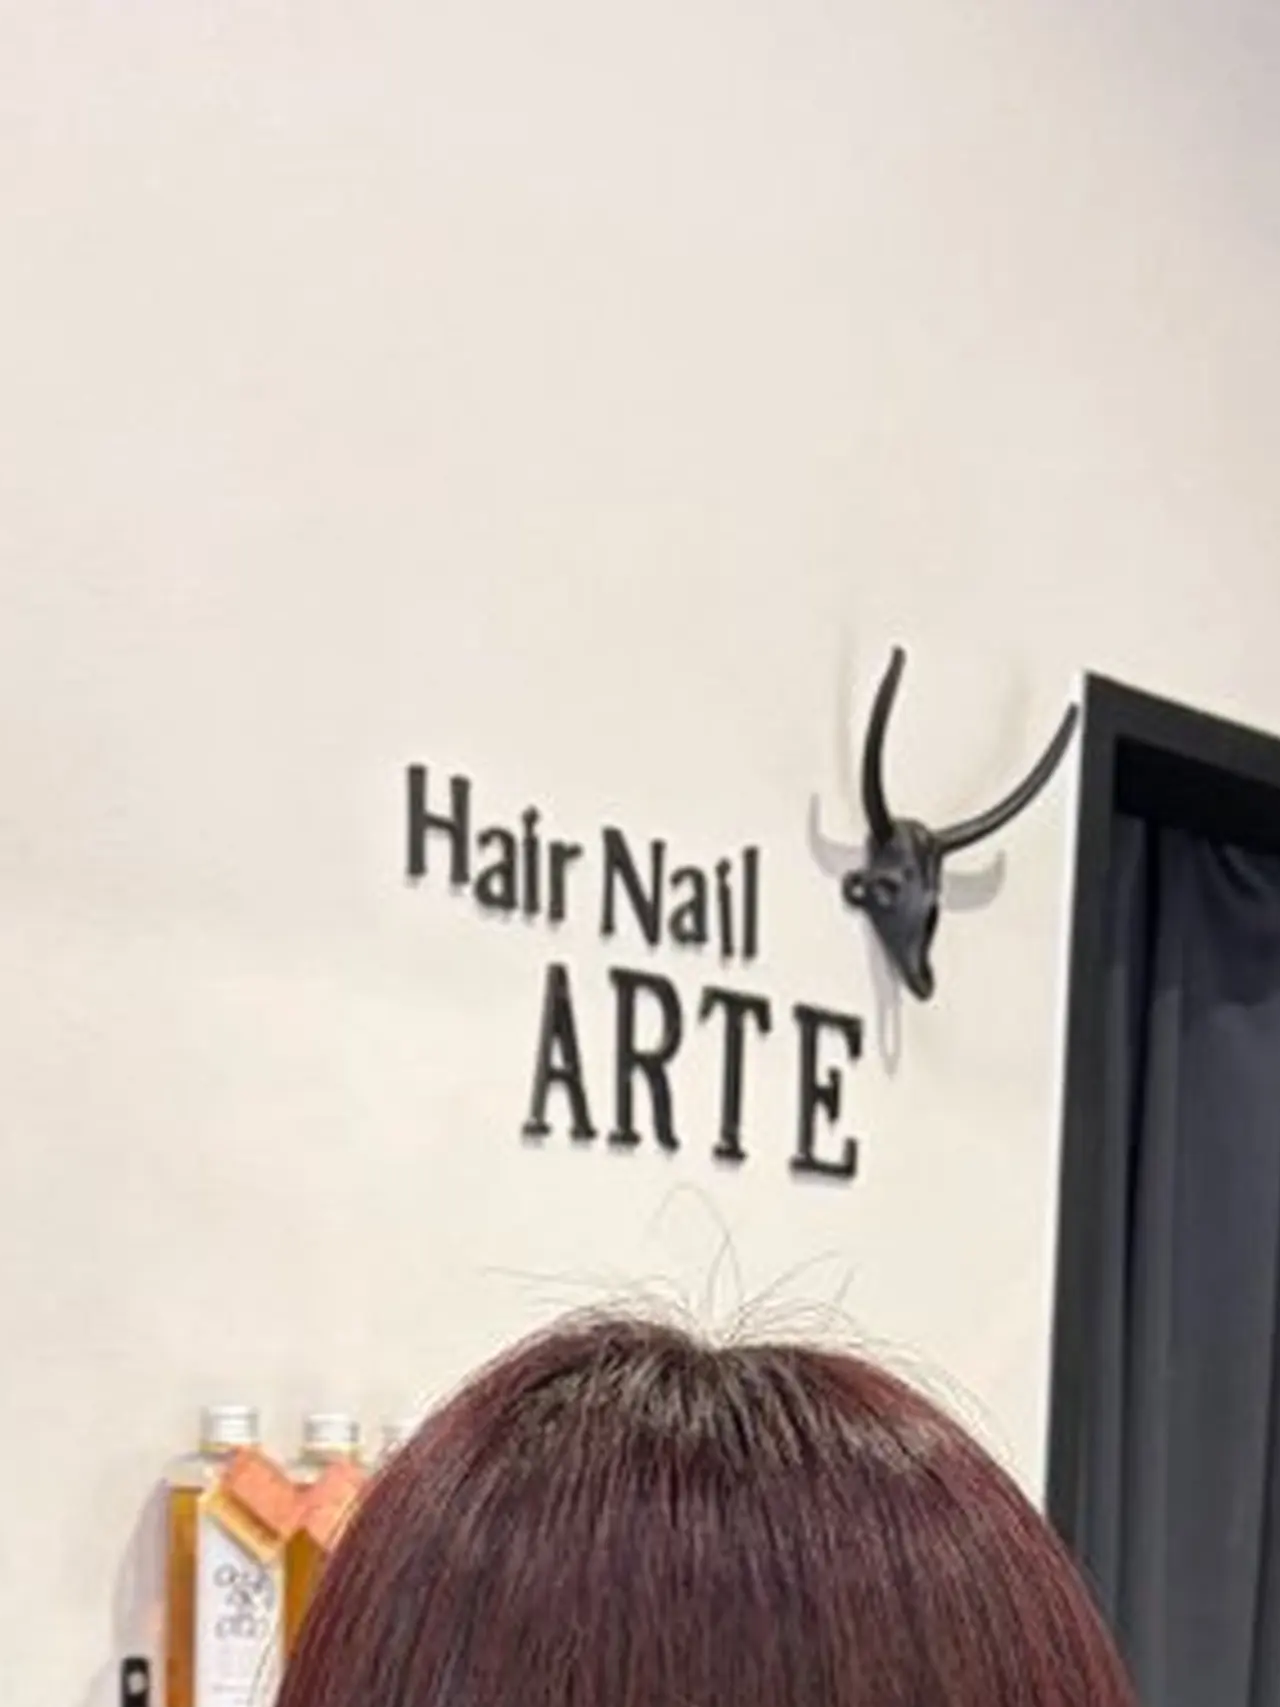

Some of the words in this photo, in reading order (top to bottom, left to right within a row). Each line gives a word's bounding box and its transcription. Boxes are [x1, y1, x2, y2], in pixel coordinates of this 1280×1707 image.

[406, 763, 583, 924] Hair
[600, 826, 760, 961] Nail
[522, 962, 863, 1181] ARTE
